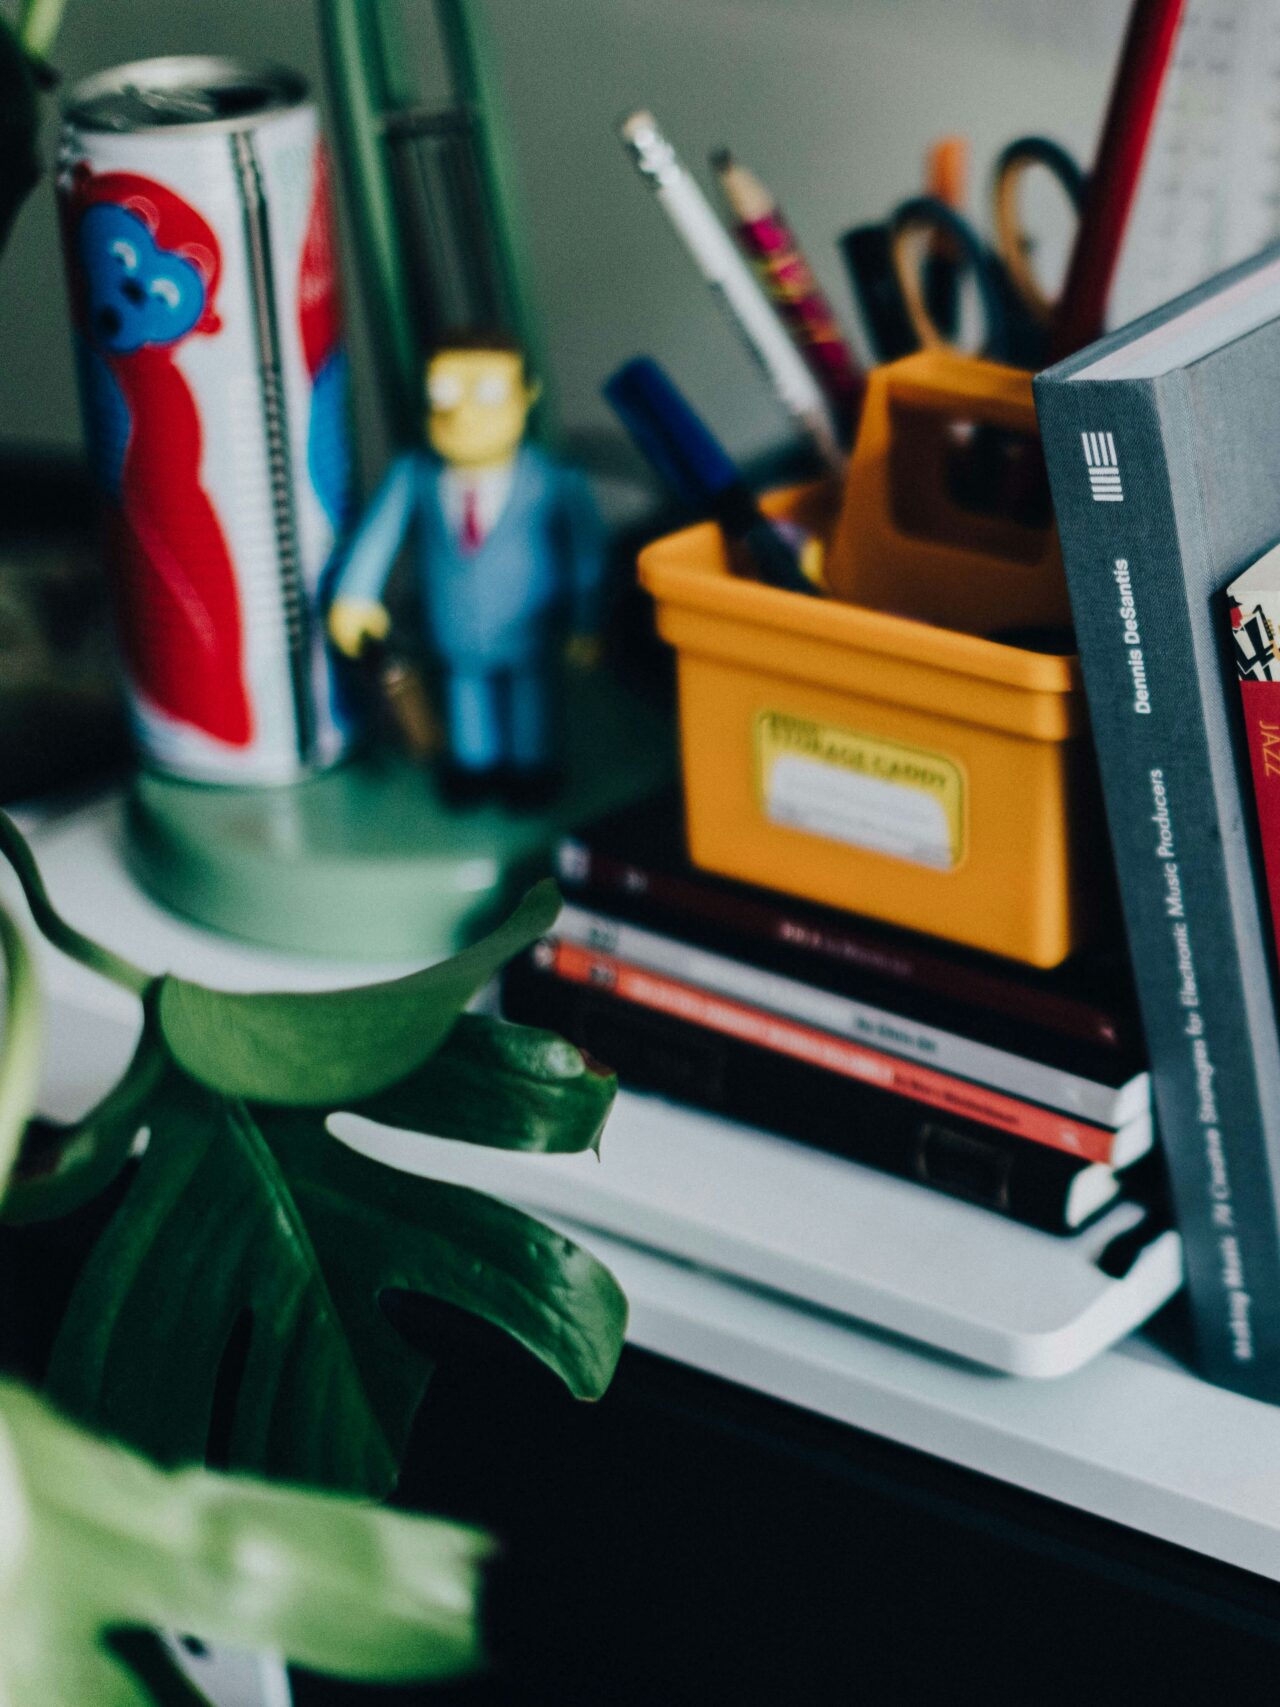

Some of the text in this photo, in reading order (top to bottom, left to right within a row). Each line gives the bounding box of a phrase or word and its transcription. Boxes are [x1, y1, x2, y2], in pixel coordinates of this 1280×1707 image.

[1113, 558, 1151, 714] Dennis DeSantis
[1150, 767, 1176, 858] Producers
[1163, 862, 1186, 918] Music
[1172, 921, 1200, 1008] Electronic
[1185, 1010, 1204, 1036] for
